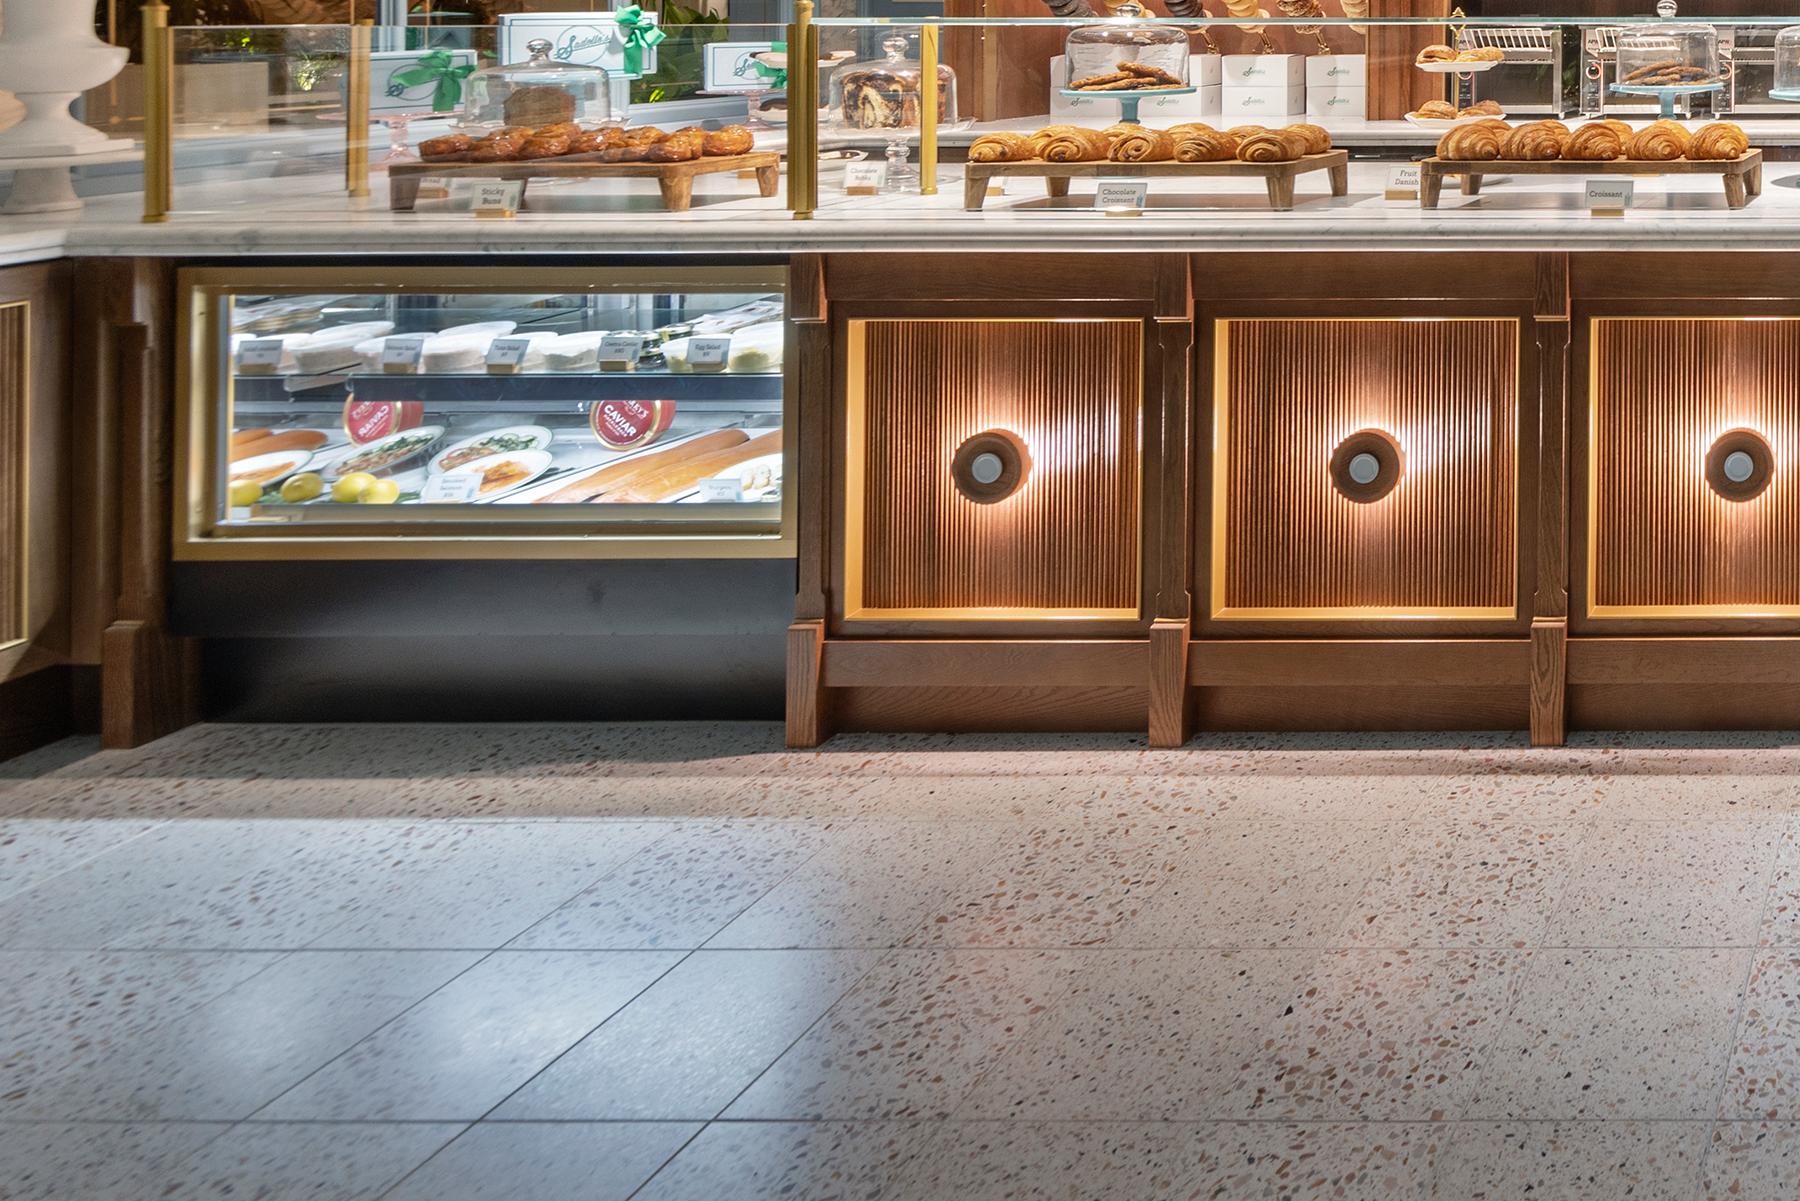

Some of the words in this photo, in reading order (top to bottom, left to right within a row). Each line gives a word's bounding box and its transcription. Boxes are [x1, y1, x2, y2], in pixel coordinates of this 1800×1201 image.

[553, 35, 611, 60] Sadelle's
[481, 188, 505, 197] Sticky
[604, 405, 636, 436] CAVIAR
